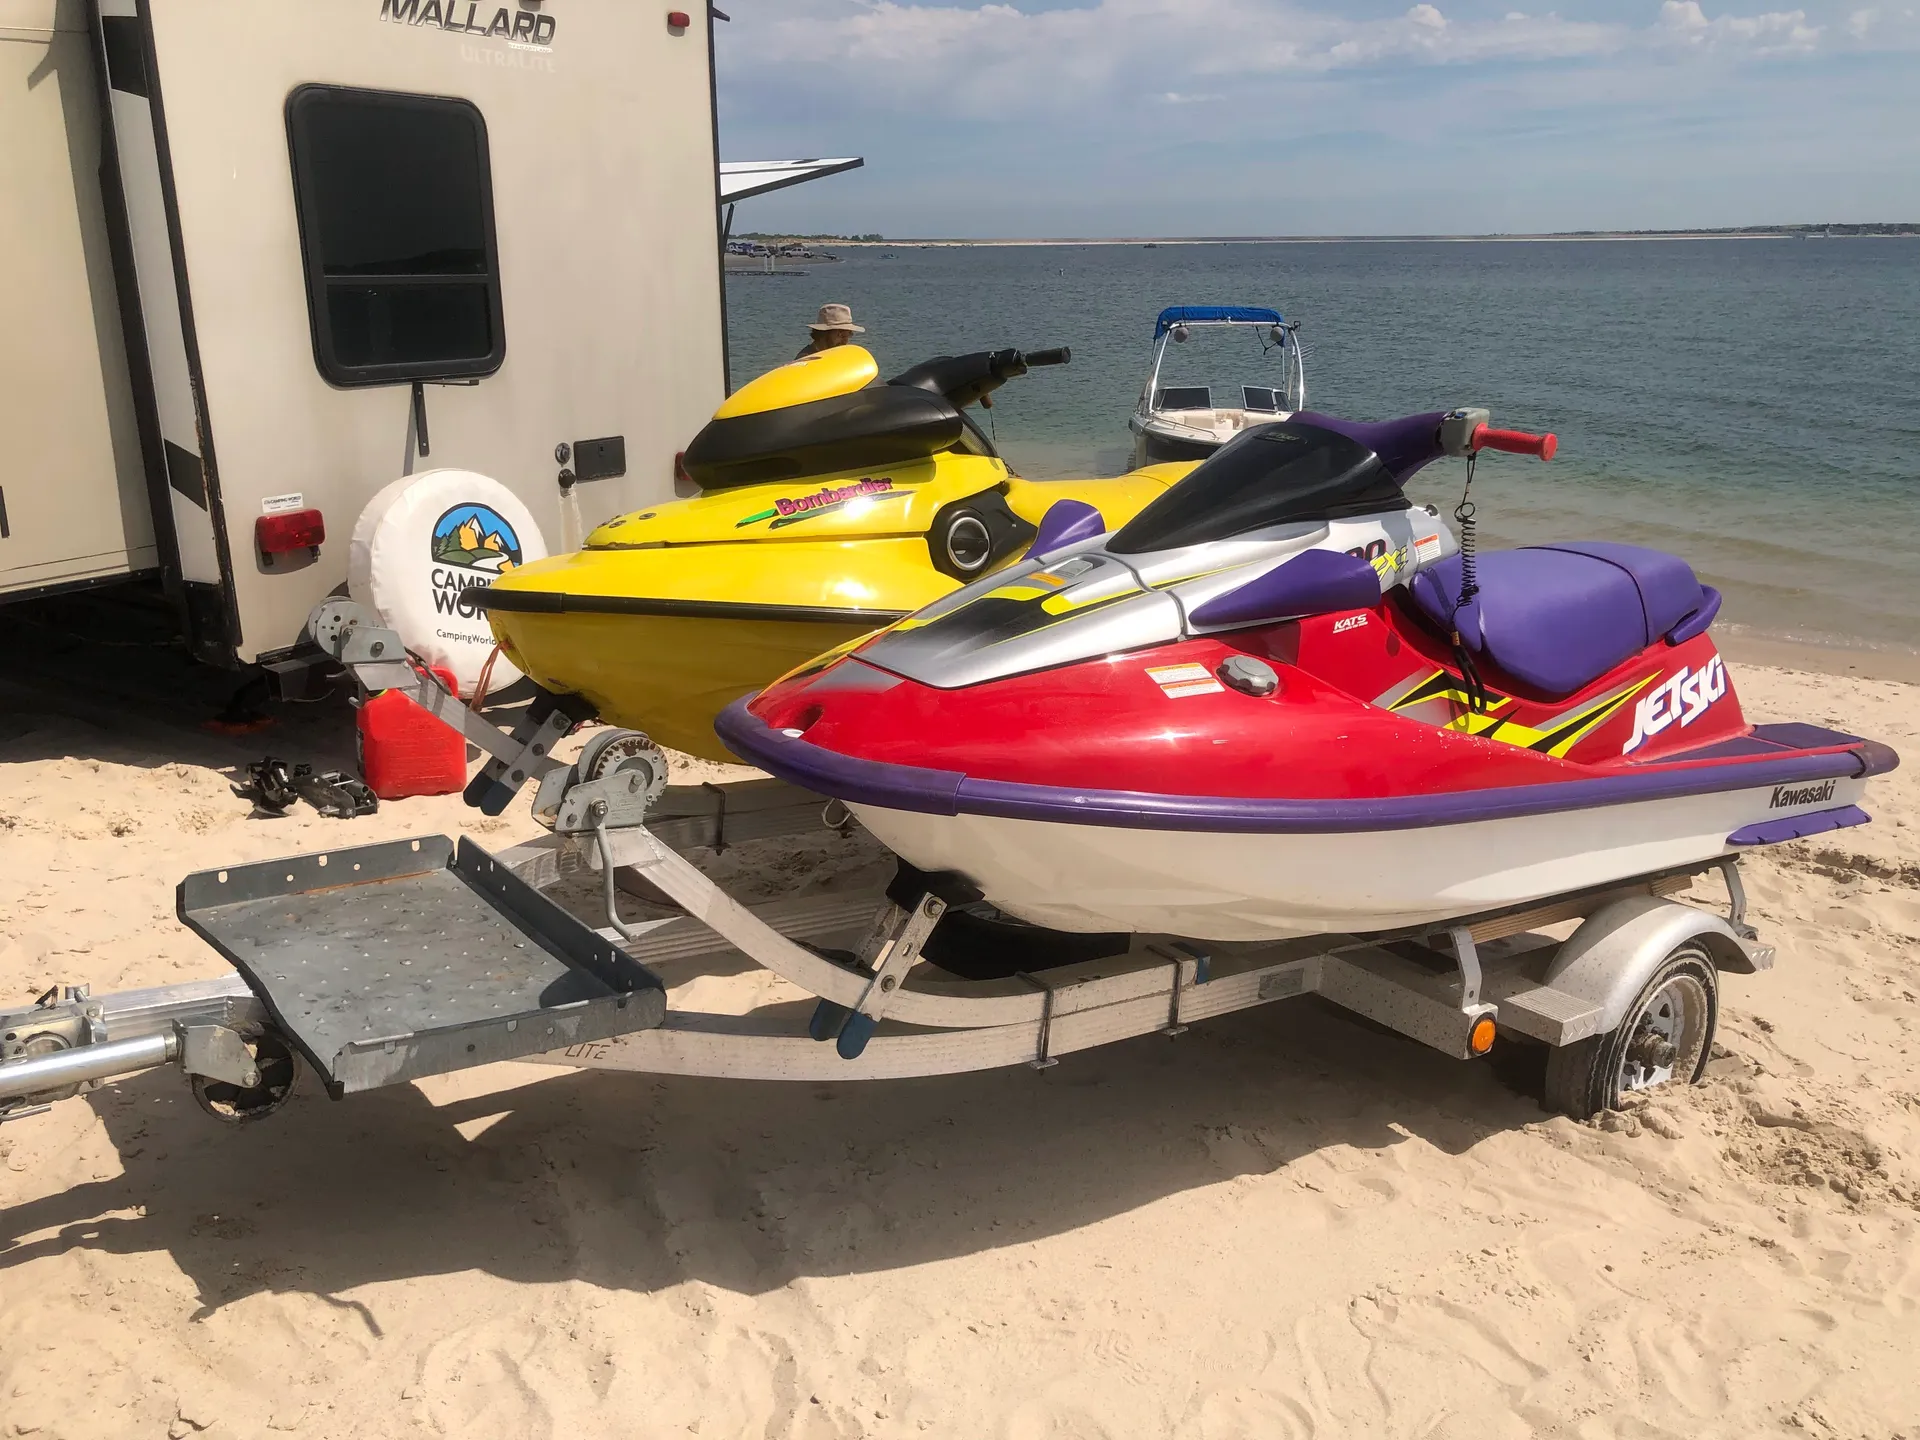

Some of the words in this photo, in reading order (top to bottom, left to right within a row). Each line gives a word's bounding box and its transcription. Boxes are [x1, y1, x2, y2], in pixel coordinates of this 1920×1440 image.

[379, 0, 557, 46] MALLARD
[775, 477, 894, 517] Bombardier
[1334, 613, 1368, 631] KATS
[1768, 780, 1837, 809] Kawasaki
[564, 1043, 612, 1060] LITE
